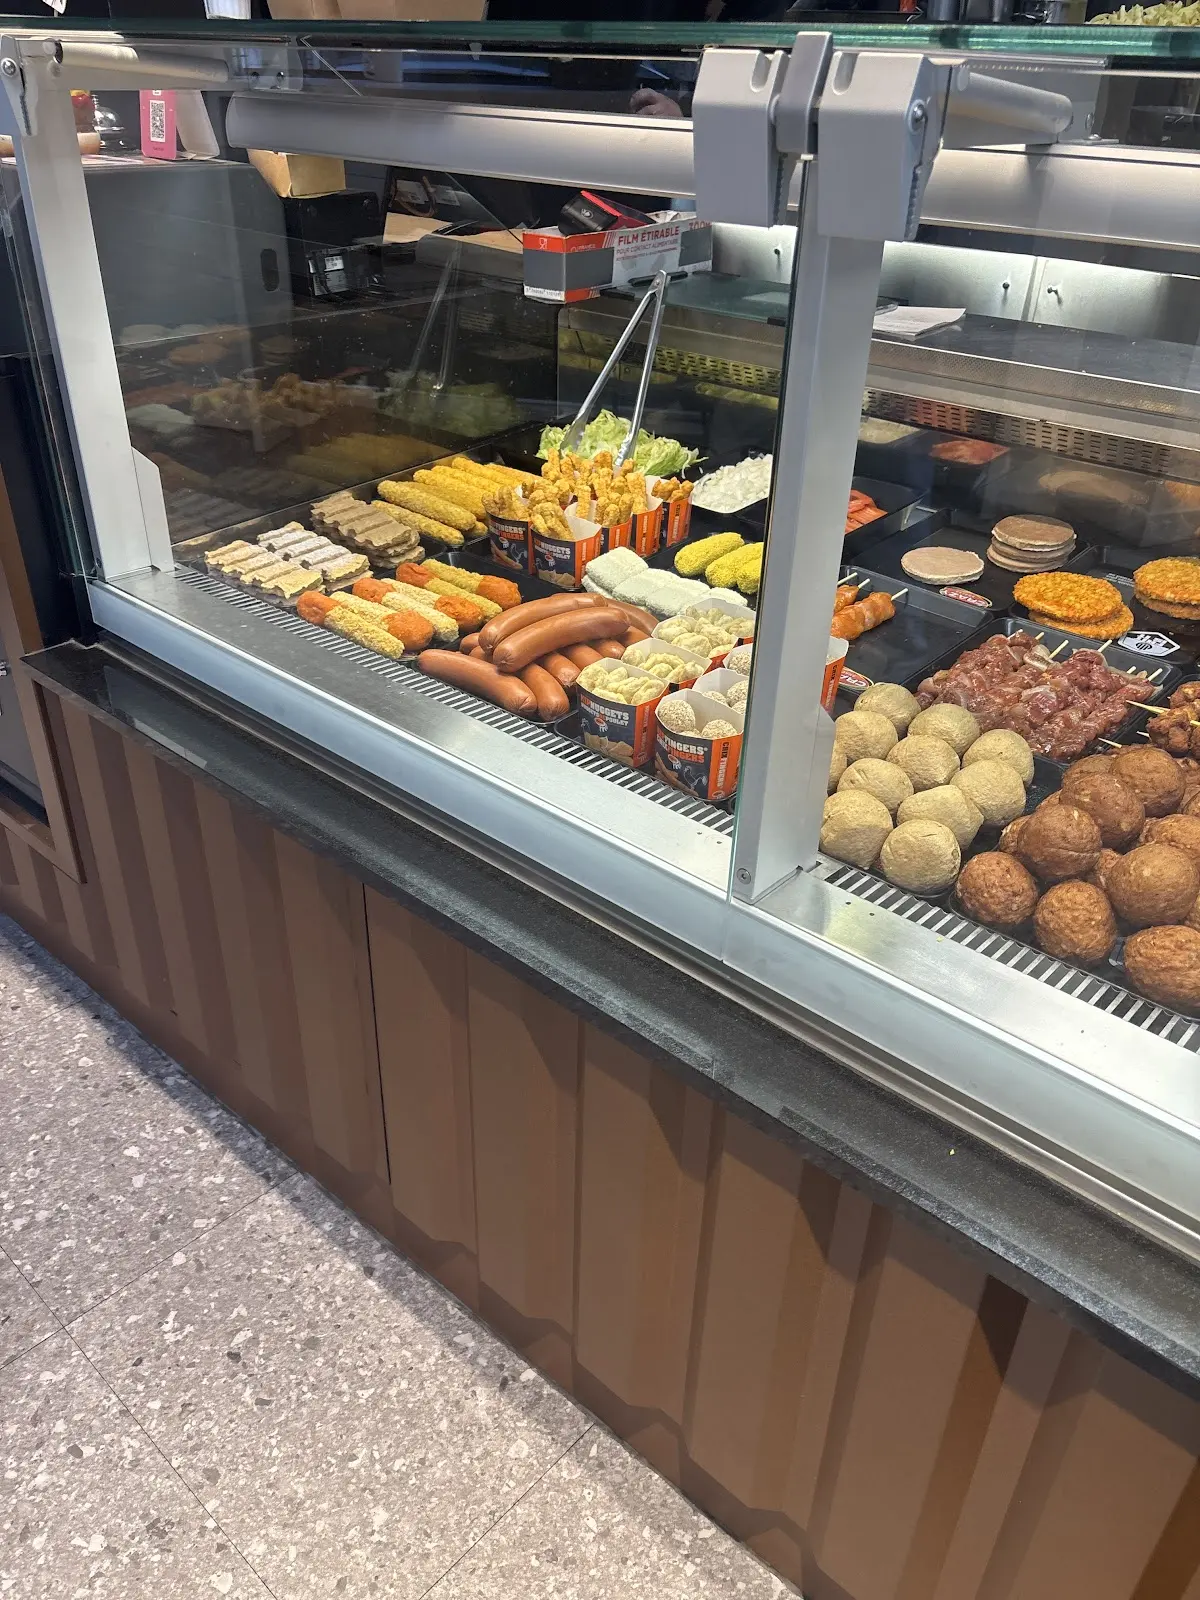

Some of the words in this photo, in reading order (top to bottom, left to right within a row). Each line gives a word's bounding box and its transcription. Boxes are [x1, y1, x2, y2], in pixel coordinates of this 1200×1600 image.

[618, 233, 638, 246] FILM
[641, 226, 680, 242] ÉTIRABLE
[616, 247, 630, 255] POUR
[631, 244, 651, 253] CONTACT
